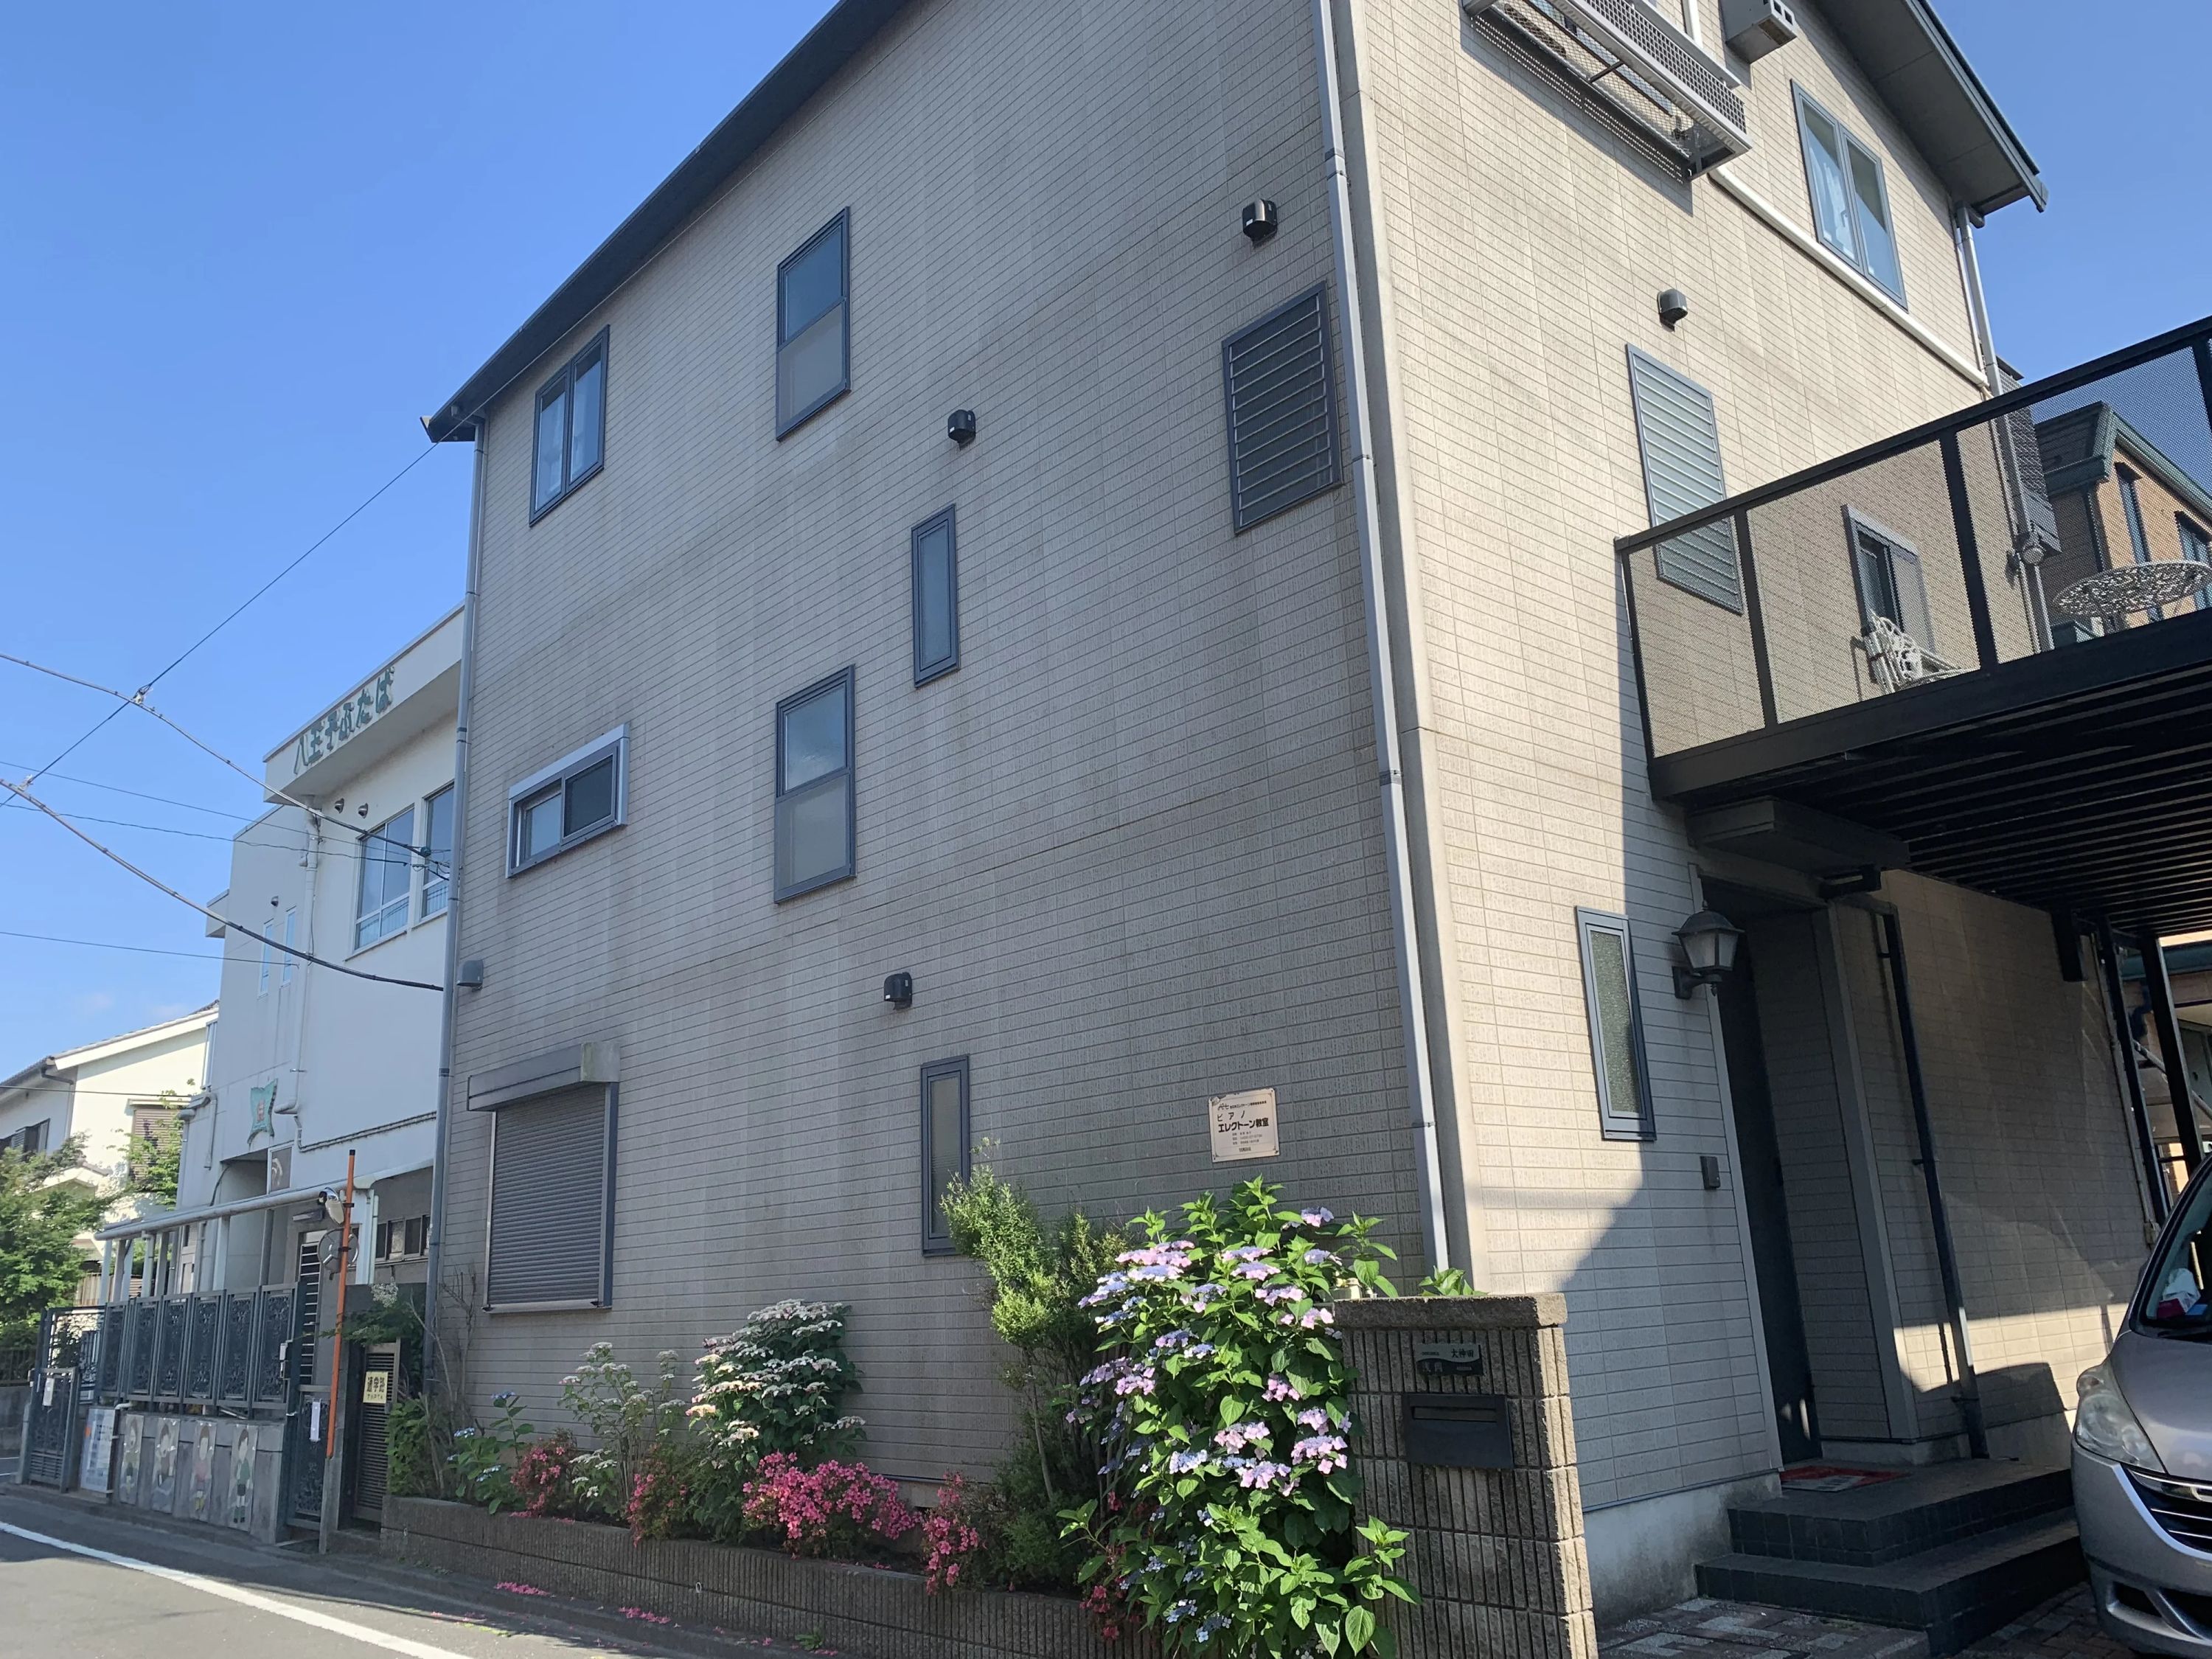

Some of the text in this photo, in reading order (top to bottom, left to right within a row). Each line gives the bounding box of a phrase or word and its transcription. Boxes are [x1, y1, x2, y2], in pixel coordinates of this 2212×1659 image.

[1218, 1117, 1269, 1133] エレクトーン教室
